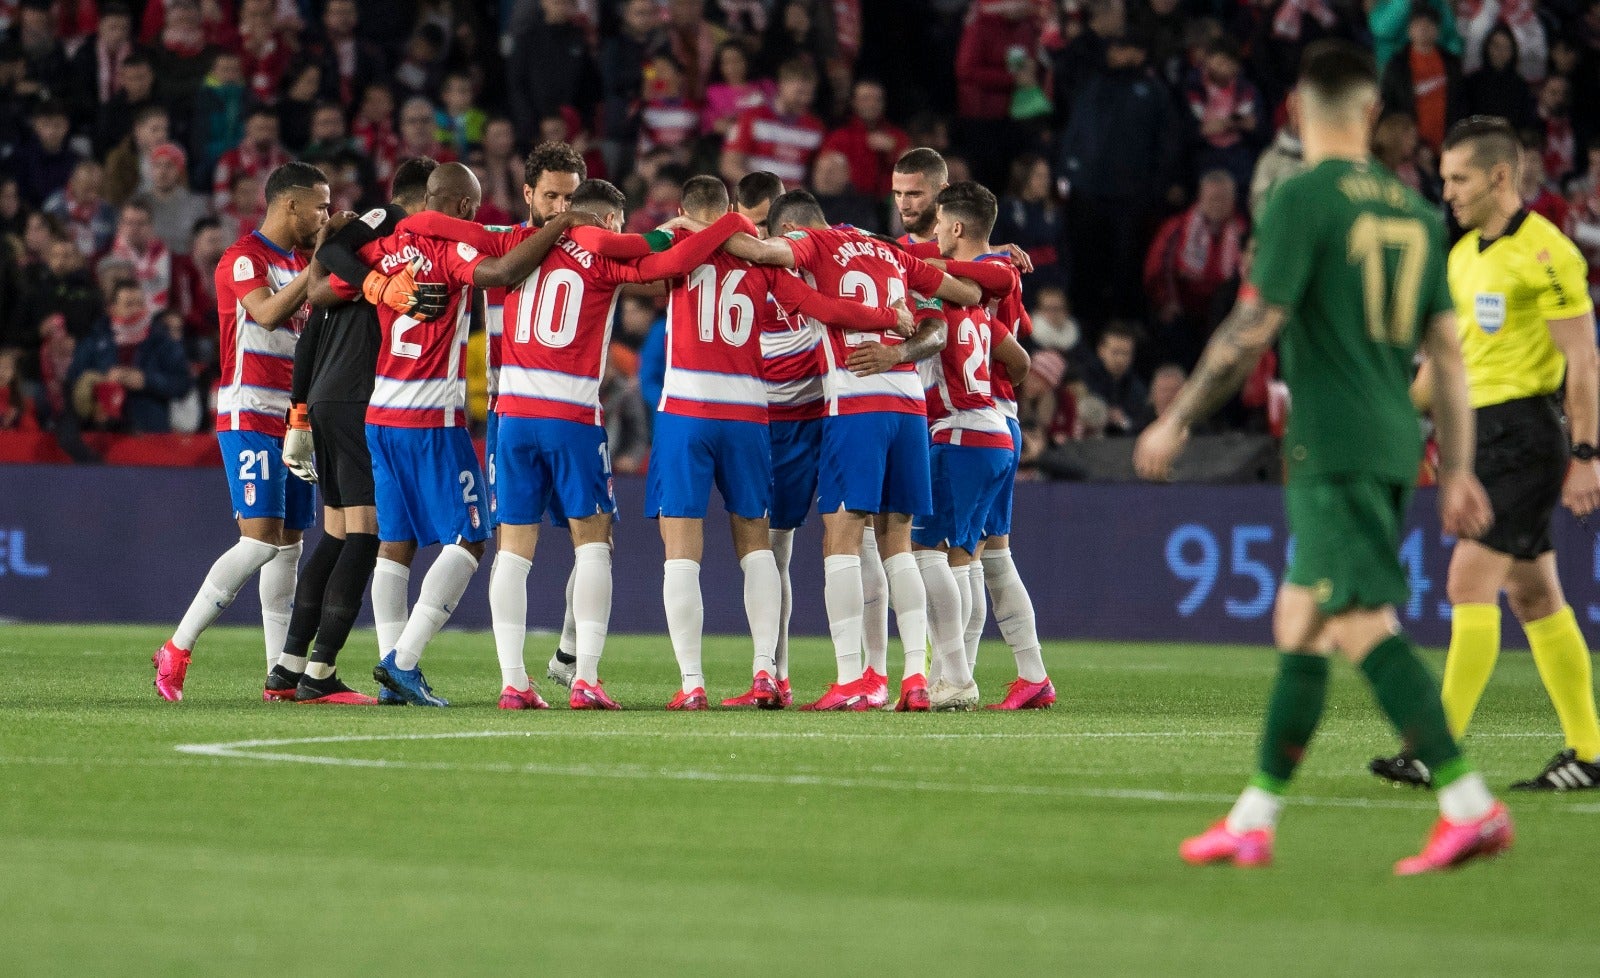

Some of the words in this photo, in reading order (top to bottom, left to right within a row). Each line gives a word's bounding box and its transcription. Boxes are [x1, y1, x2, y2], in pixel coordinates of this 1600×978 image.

[832, 241, 876, 267] CARLOS
[1346, 212, 1429, 347] 17
[390, 313, 422, 360] 2
[514, 264, 585, 348] 10
[687, 263, 754, 347] 16
[239, 449, 270, 480] 21
[458, 470, 478, 503] 2
[1166, 523, 1296, 617] 95
